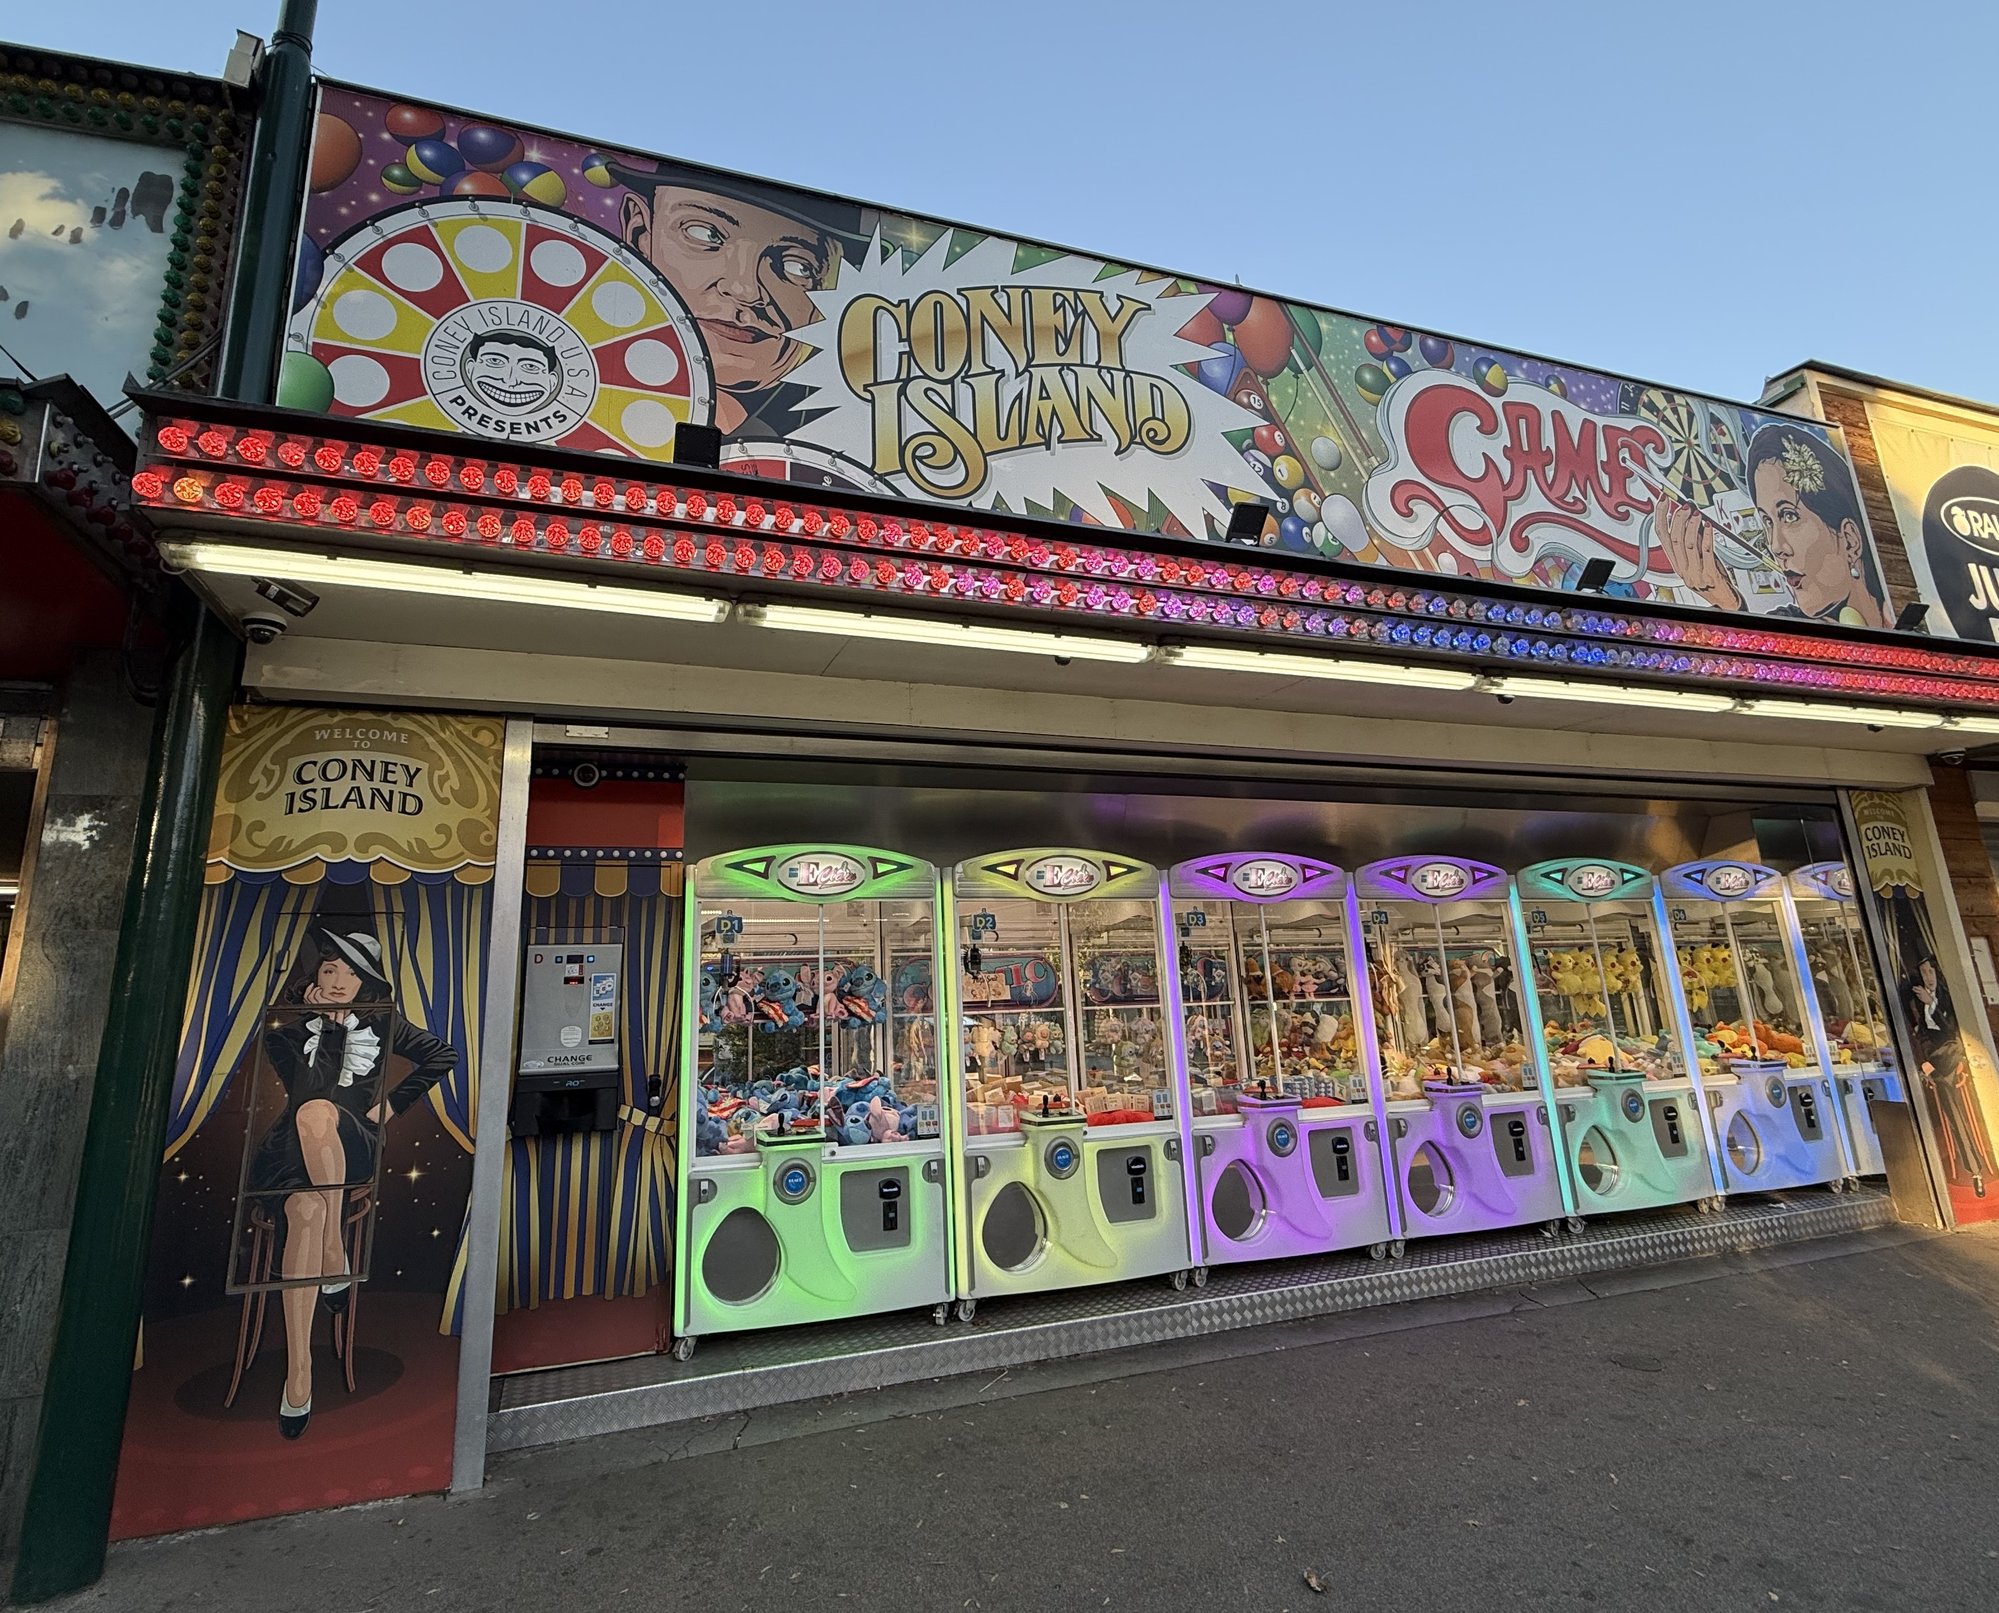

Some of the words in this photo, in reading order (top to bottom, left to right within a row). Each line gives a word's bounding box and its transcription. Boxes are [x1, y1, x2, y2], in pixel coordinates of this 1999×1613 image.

[431, 316, 474, 381] CONEY
[478, 306, 565, 344] ISLAND
[838, 285, 1151, 402] CONEY
[1251, 396, 1263, 407] 15
[449, 395, 568, 435] PRESENTS
[863, 365, 1191, 499] ISLAND
[314, 728, 409, 744] WELCOME
[352, 740, 371, 749] TO
[293, 758, 422, 788] CONEY
[284, 786, 424, 816] ISLAND
[1864, 826, 1905, 843] CONEY
[1866, 842, 1912, 860] ISLAND
[720, 918, 740, 932] D1
[976, 917, 993, 927] D2
[1188, 915, 1204, 925] D3
[1373, 914, 1387, 922] D4
[534, 954, 543, 964] D
[547, 1054, 593, 1063] CHANGE
